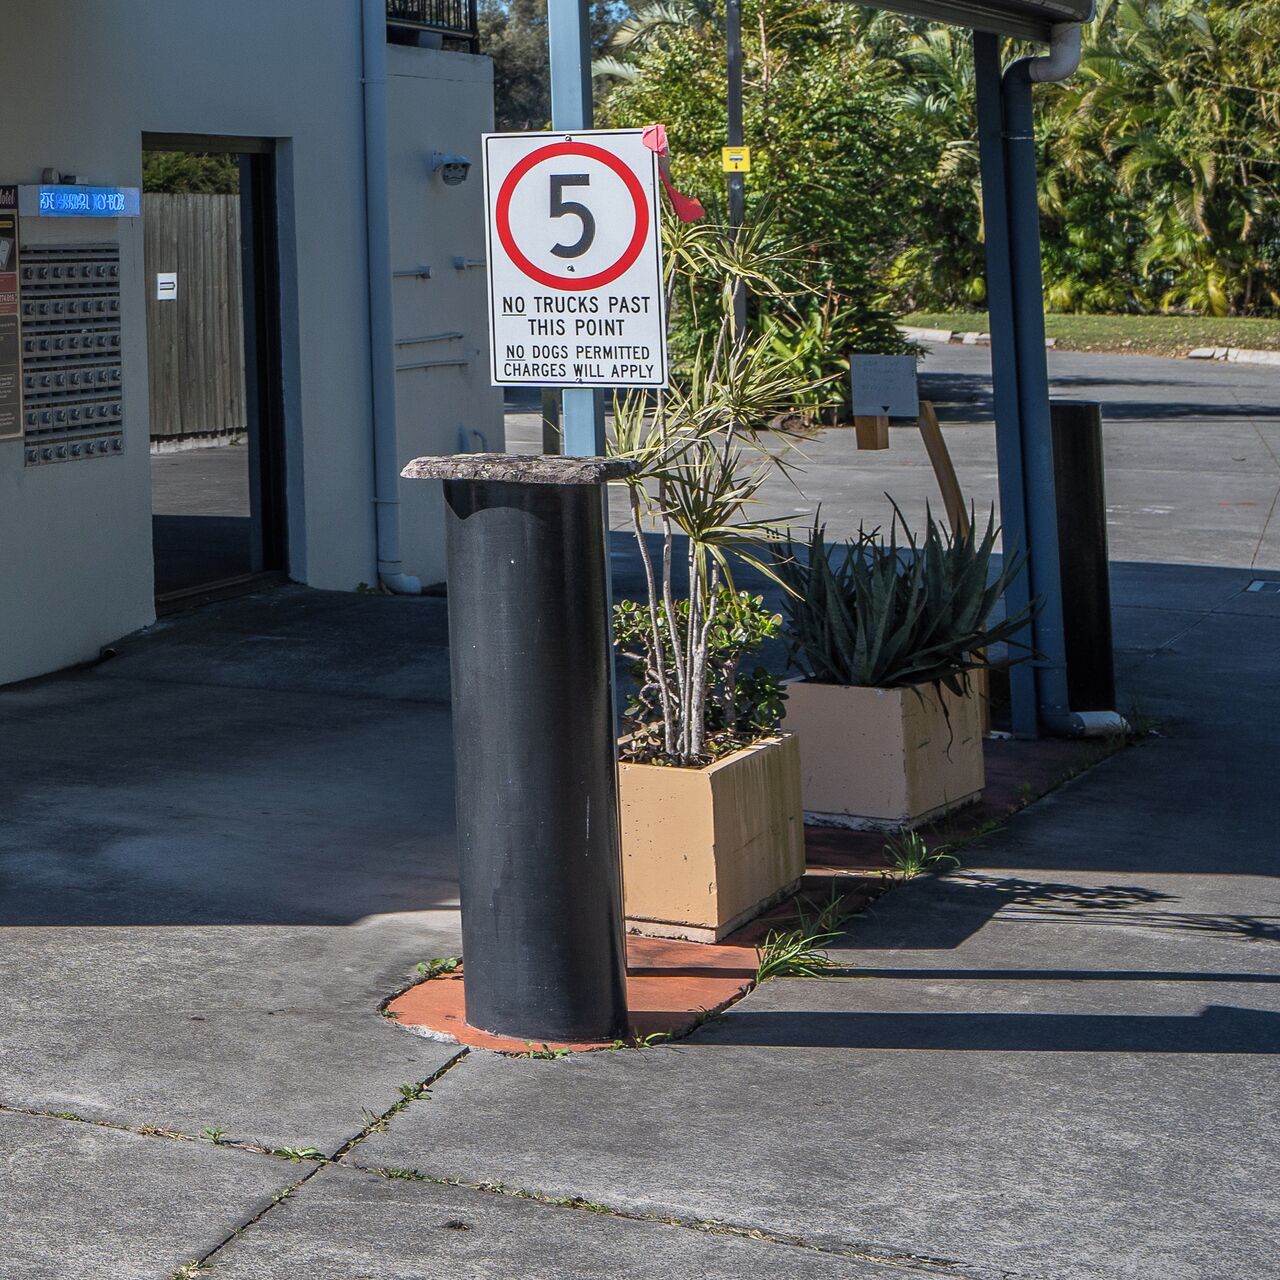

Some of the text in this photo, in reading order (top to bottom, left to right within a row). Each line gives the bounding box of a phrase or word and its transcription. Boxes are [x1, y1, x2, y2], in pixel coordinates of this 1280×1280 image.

[549, 173, 596, 259] 5
[502, 296, 650, 314] NO TRUCKS PAST
[528, 319, 625, 337] THIS POINT
[505, 345, 650, 360] NO DOGS PERMITTED
[504, 363, 654, 379] CHARGES WILL APPLY
